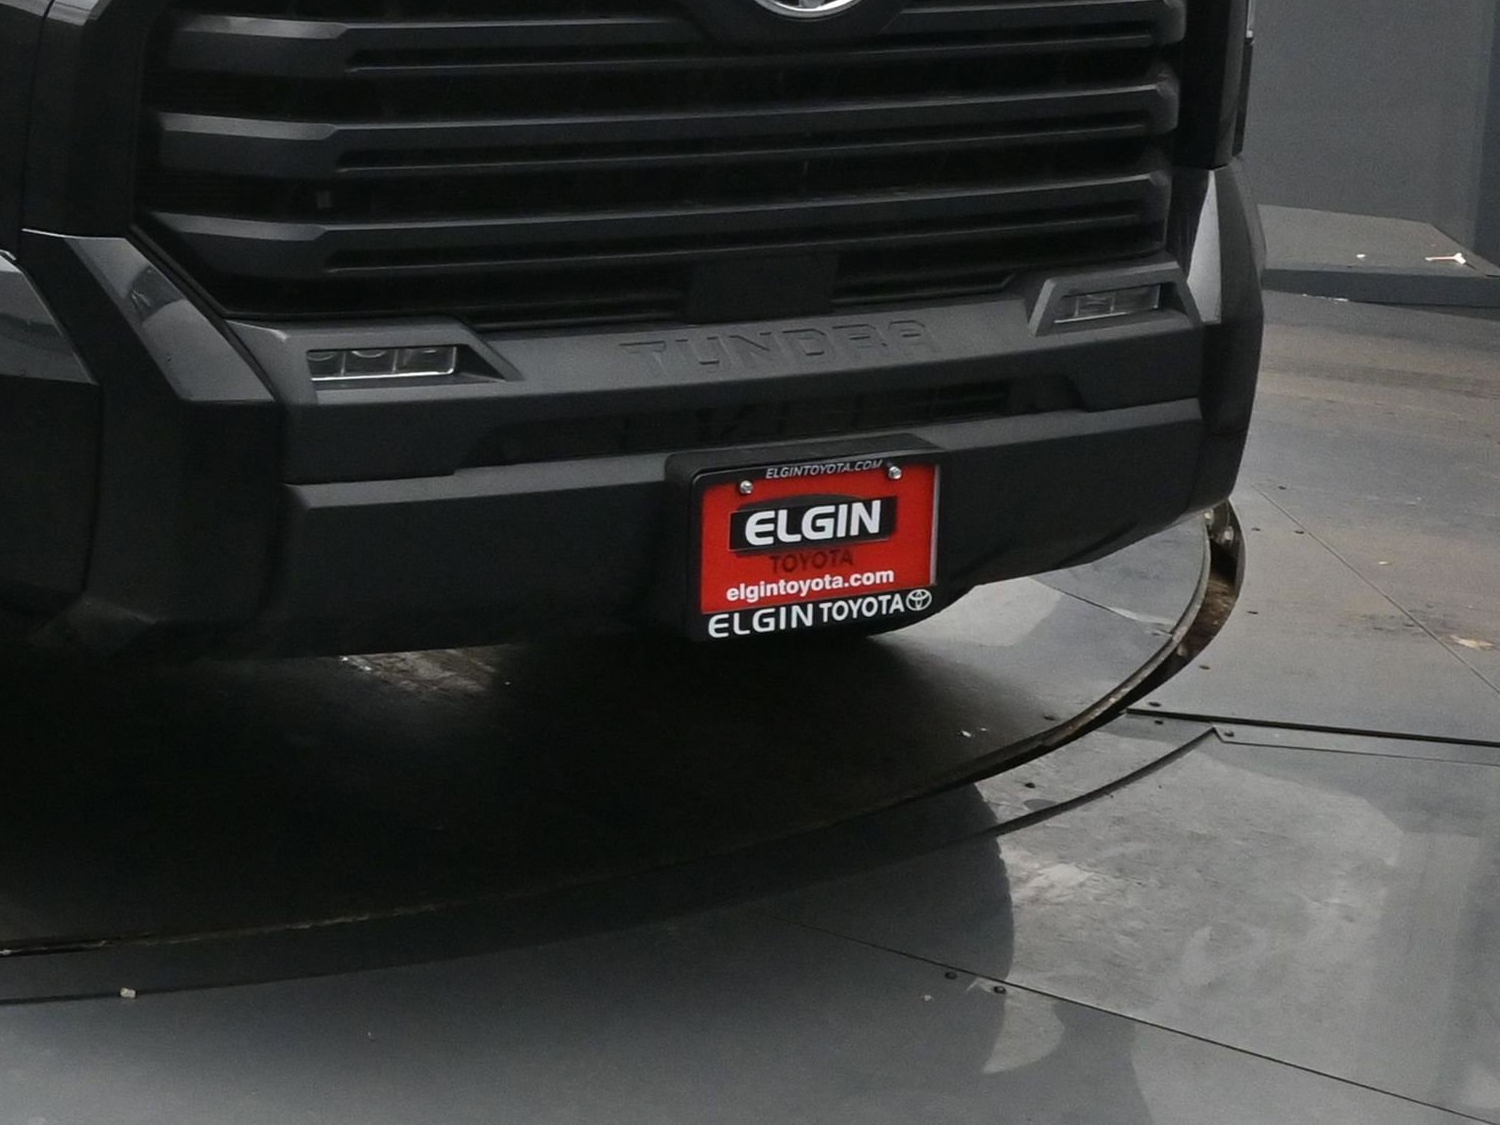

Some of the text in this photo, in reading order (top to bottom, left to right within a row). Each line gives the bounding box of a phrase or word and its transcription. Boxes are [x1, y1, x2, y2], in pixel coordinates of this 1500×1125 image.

[618, 320, 936, 374] TUNDRA
[764, 459, 883, 480] ELGINTOYOTA.COM
[744, 499, 882, 547] ELGIN
[768, 548, 854, 574] TOYOTA
[726, 569, 895, 603] elgintoyota.com
[707, 593, 906, 639] ELGIN TOYOTA
